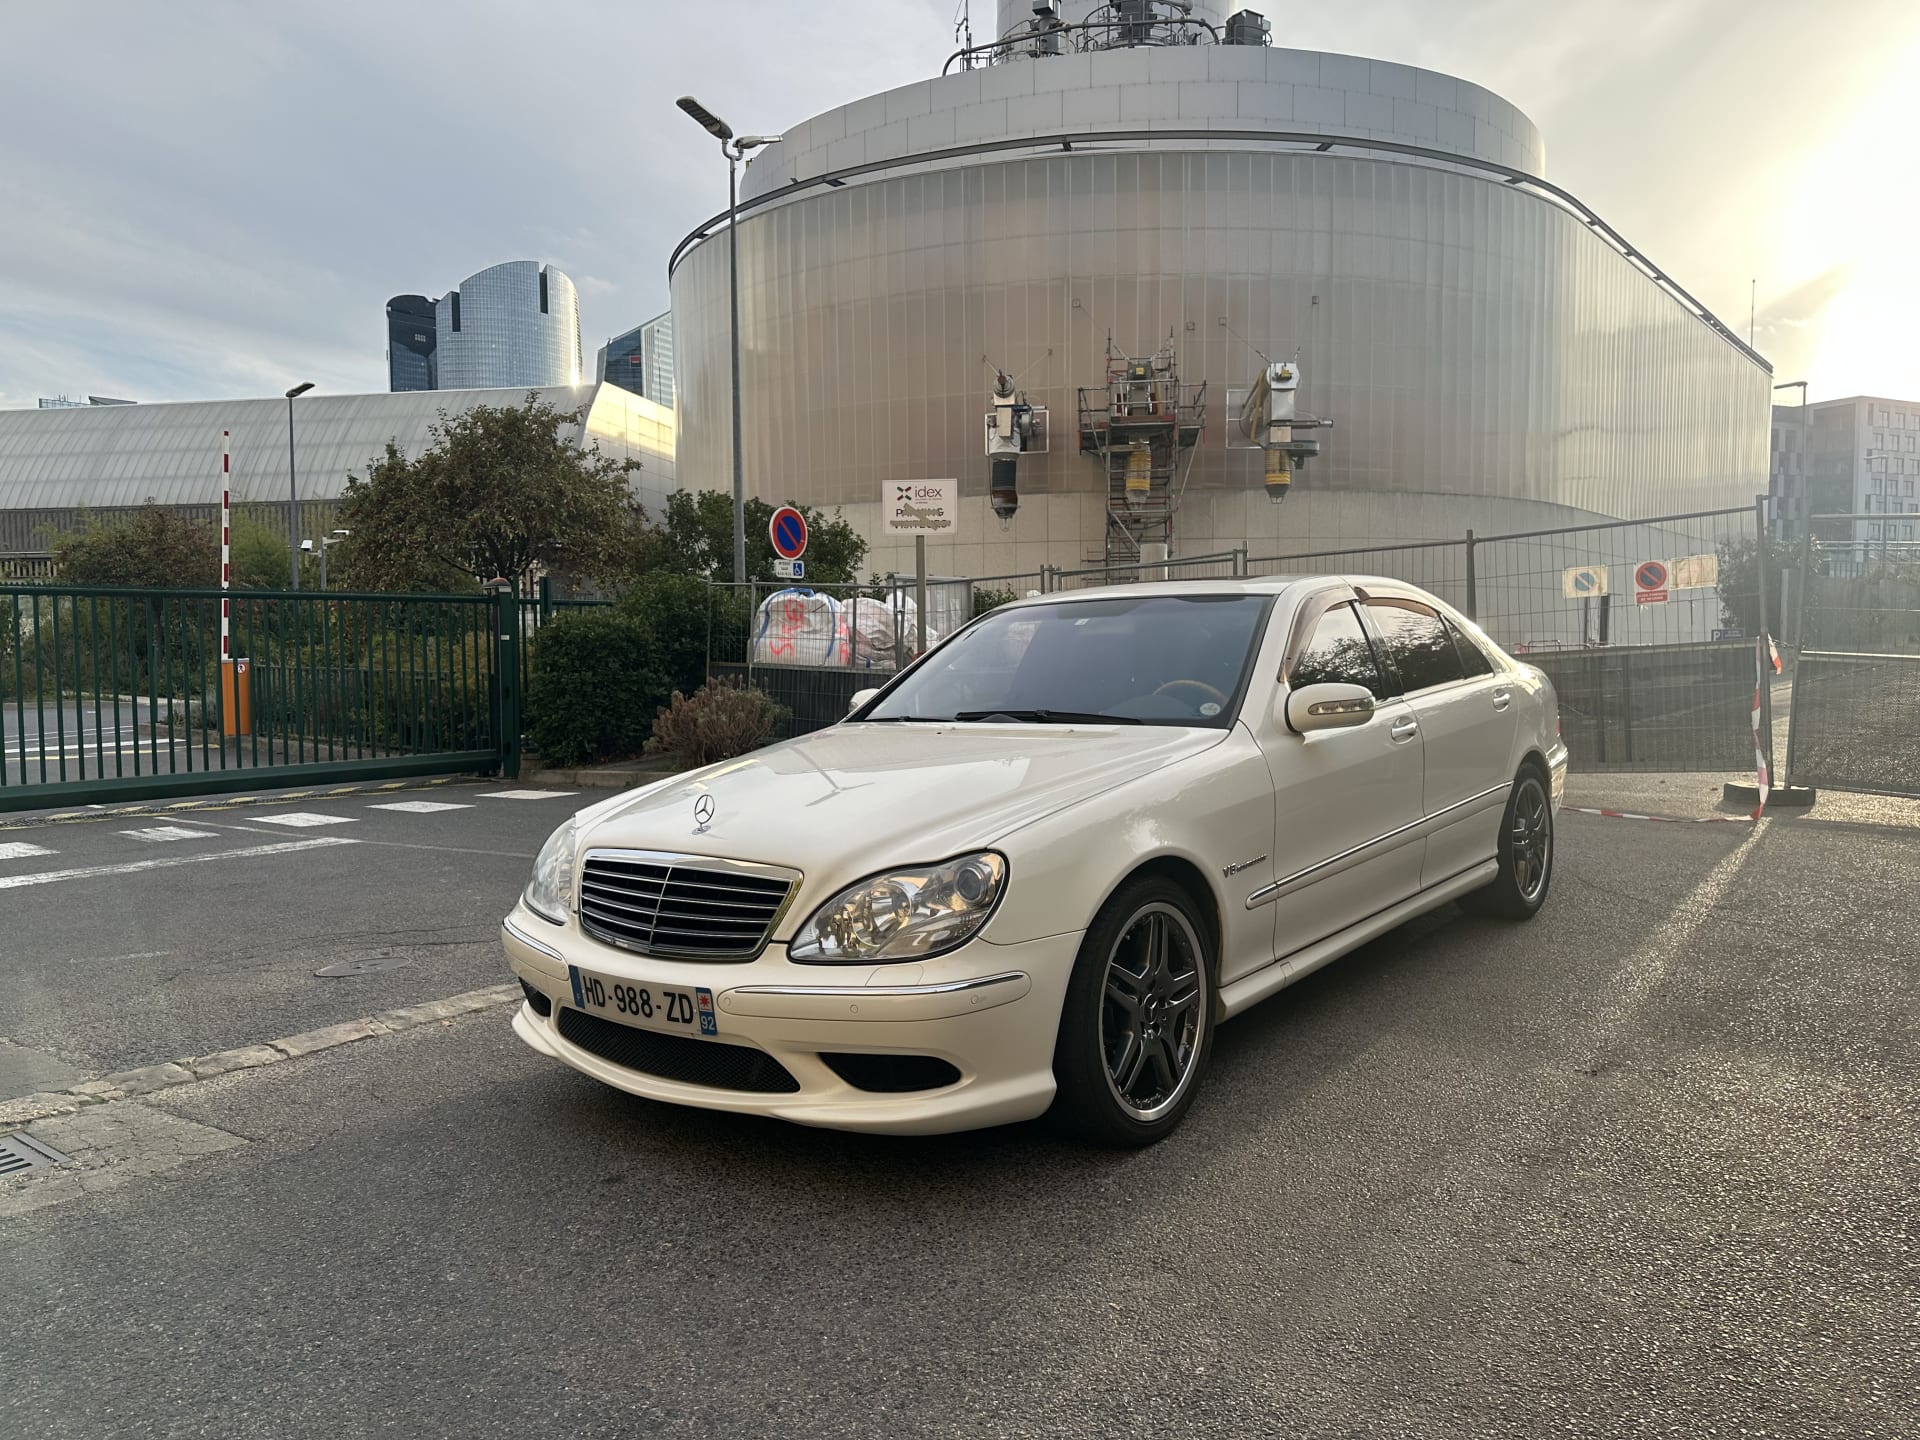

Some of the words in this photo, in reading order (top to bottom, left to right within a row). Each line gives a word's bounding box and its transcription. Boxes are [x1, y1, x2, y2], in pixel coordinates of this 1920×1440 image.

[915, 486, 942, 498] idex
[582, 975, 694, 1025] HD-988-ZD
[701, 1015, 716, 1030] 92
